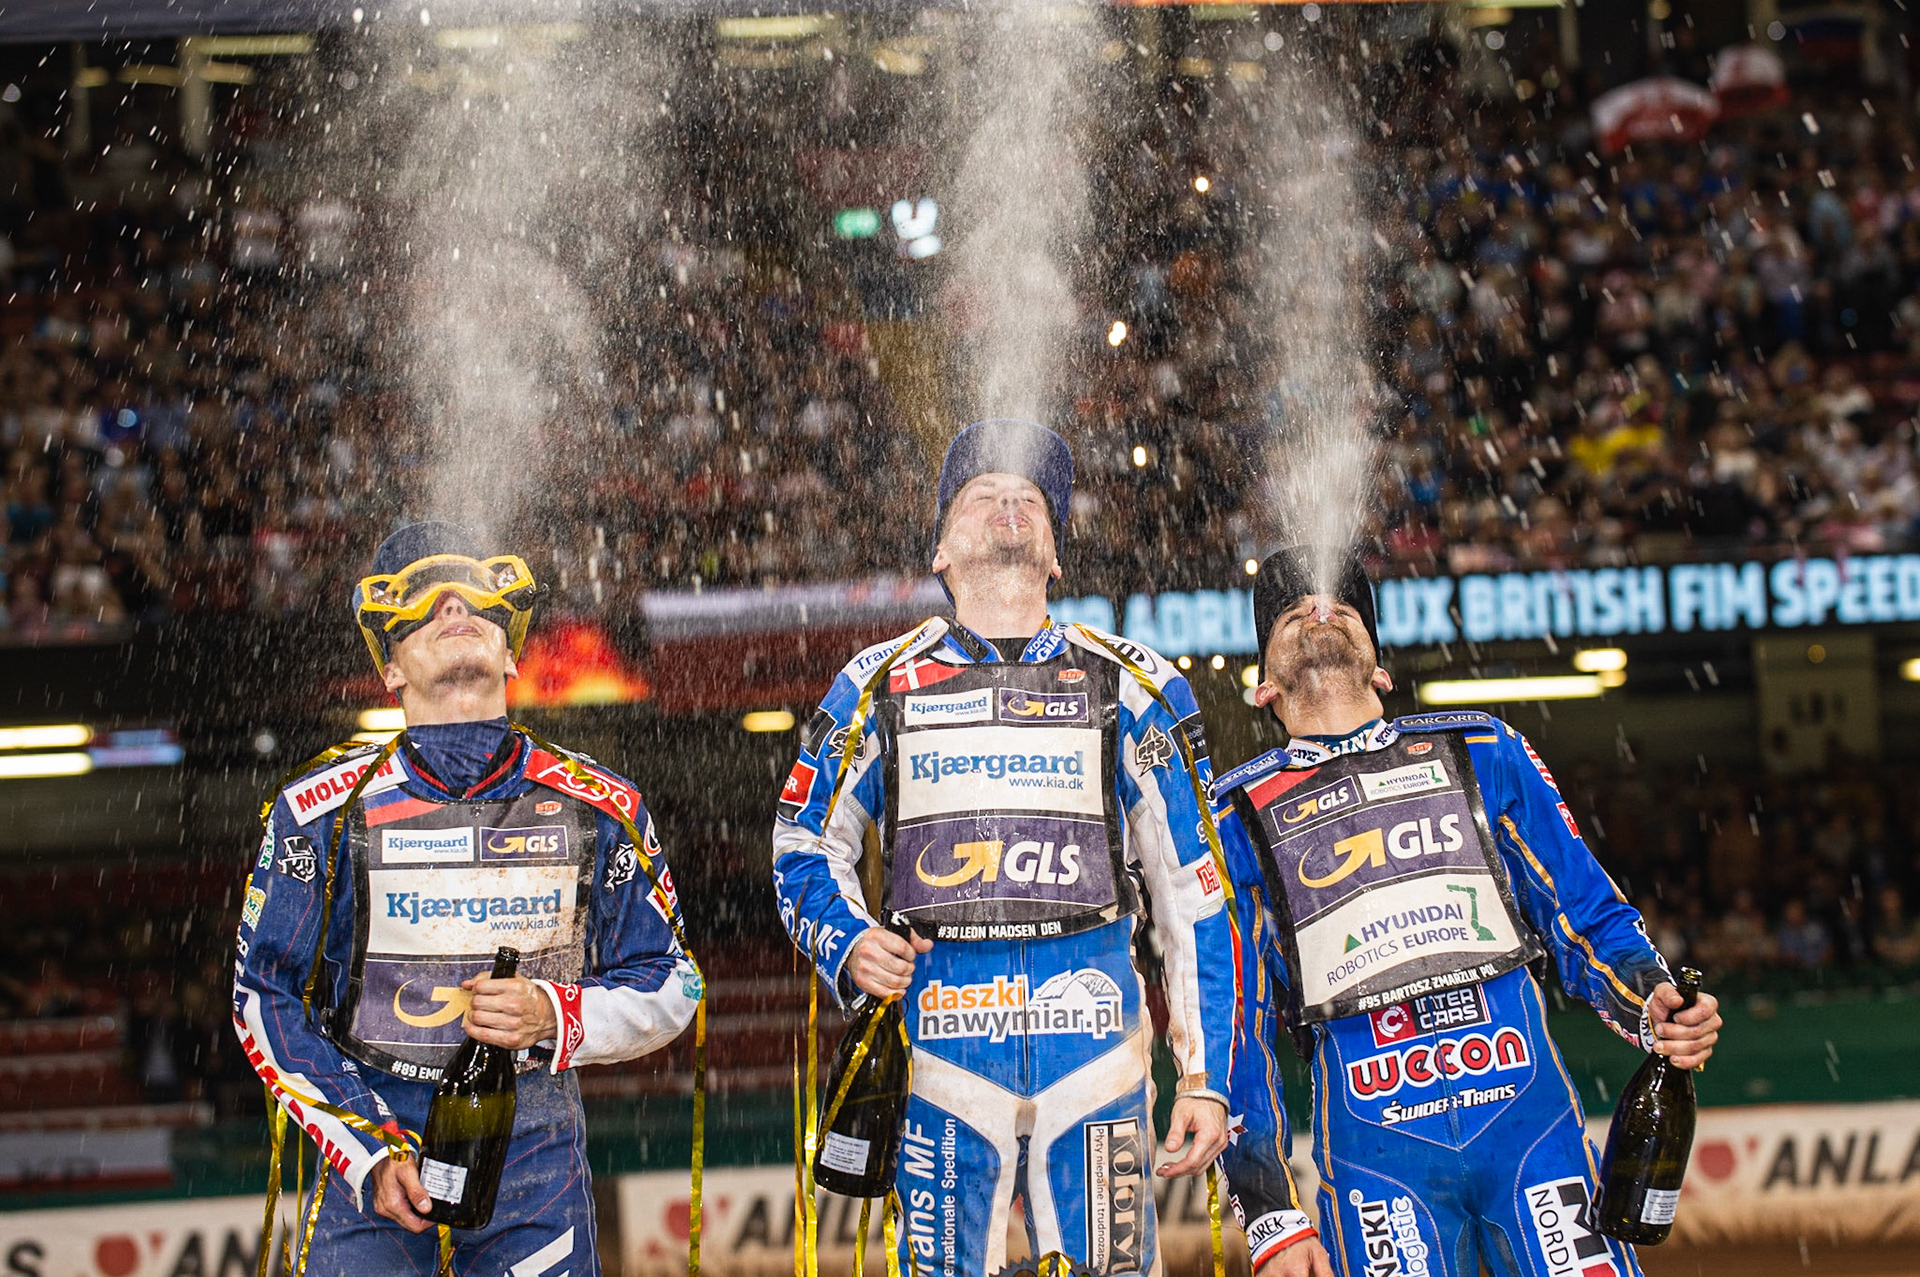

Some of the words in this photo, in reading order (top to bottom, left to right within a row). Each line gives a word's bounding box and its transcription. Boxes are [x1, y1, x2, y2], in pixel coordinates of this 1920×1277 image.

[1458, 566, 1664, 641] BRITISH
[1668, 560, 1766, 633] FIM
[910, 697, 987, 714] Kjærgaard
[1045, 701, 1078, 716] GLS
[910, 751, 1084, 784] Kjærgaard
[1009, 777, 1084, 790] www.kia.dk
[1386, 772, 1428, 785] HYUNDAI
[1317, 786, 1349, 811] GLS
[1402, 780, 1430, 789] EUROPE
[388, 836, 468, 851] Kjærgaard
[526, 835, 559, 852] GLS
[1387, 814, 1464, 860] GLS
[1004, 841, 1081, 886] GLS
[386, 889, 562, 924] Kjærgaard
[490, 918, 560, 930] www.kia.dk
[938, 926, 958, 939] #30
[960, 924, 986, 938] LEON
[989, 923, 1036, 938] MADSEN
[1041, 921, 1062, 935] DEN
[1361, 904, 1463, 943] HYUNDAI
[1327, 940, 1399, 986] ROBOTICS
[1402, 927, 1469, 949] EUROPE
[921, 979, 1024, 1011] daszki
[1358, 994, 1380, 1012] #95
[1382, 980, 1432, 1005] BARTOSZ
[1480, 963, 1499, 977] POL
[921, 1001, 1119, 1038] nawymiar.pl
[1420, 1004, 1479, 1029] CARS
[391, 1060, 418, 1077] #89
[904, 1118, 936, 1180] MF
[940, 1118, 958, 1189] Spedition
[1096, 1155, 1105, 1199] niepalne
